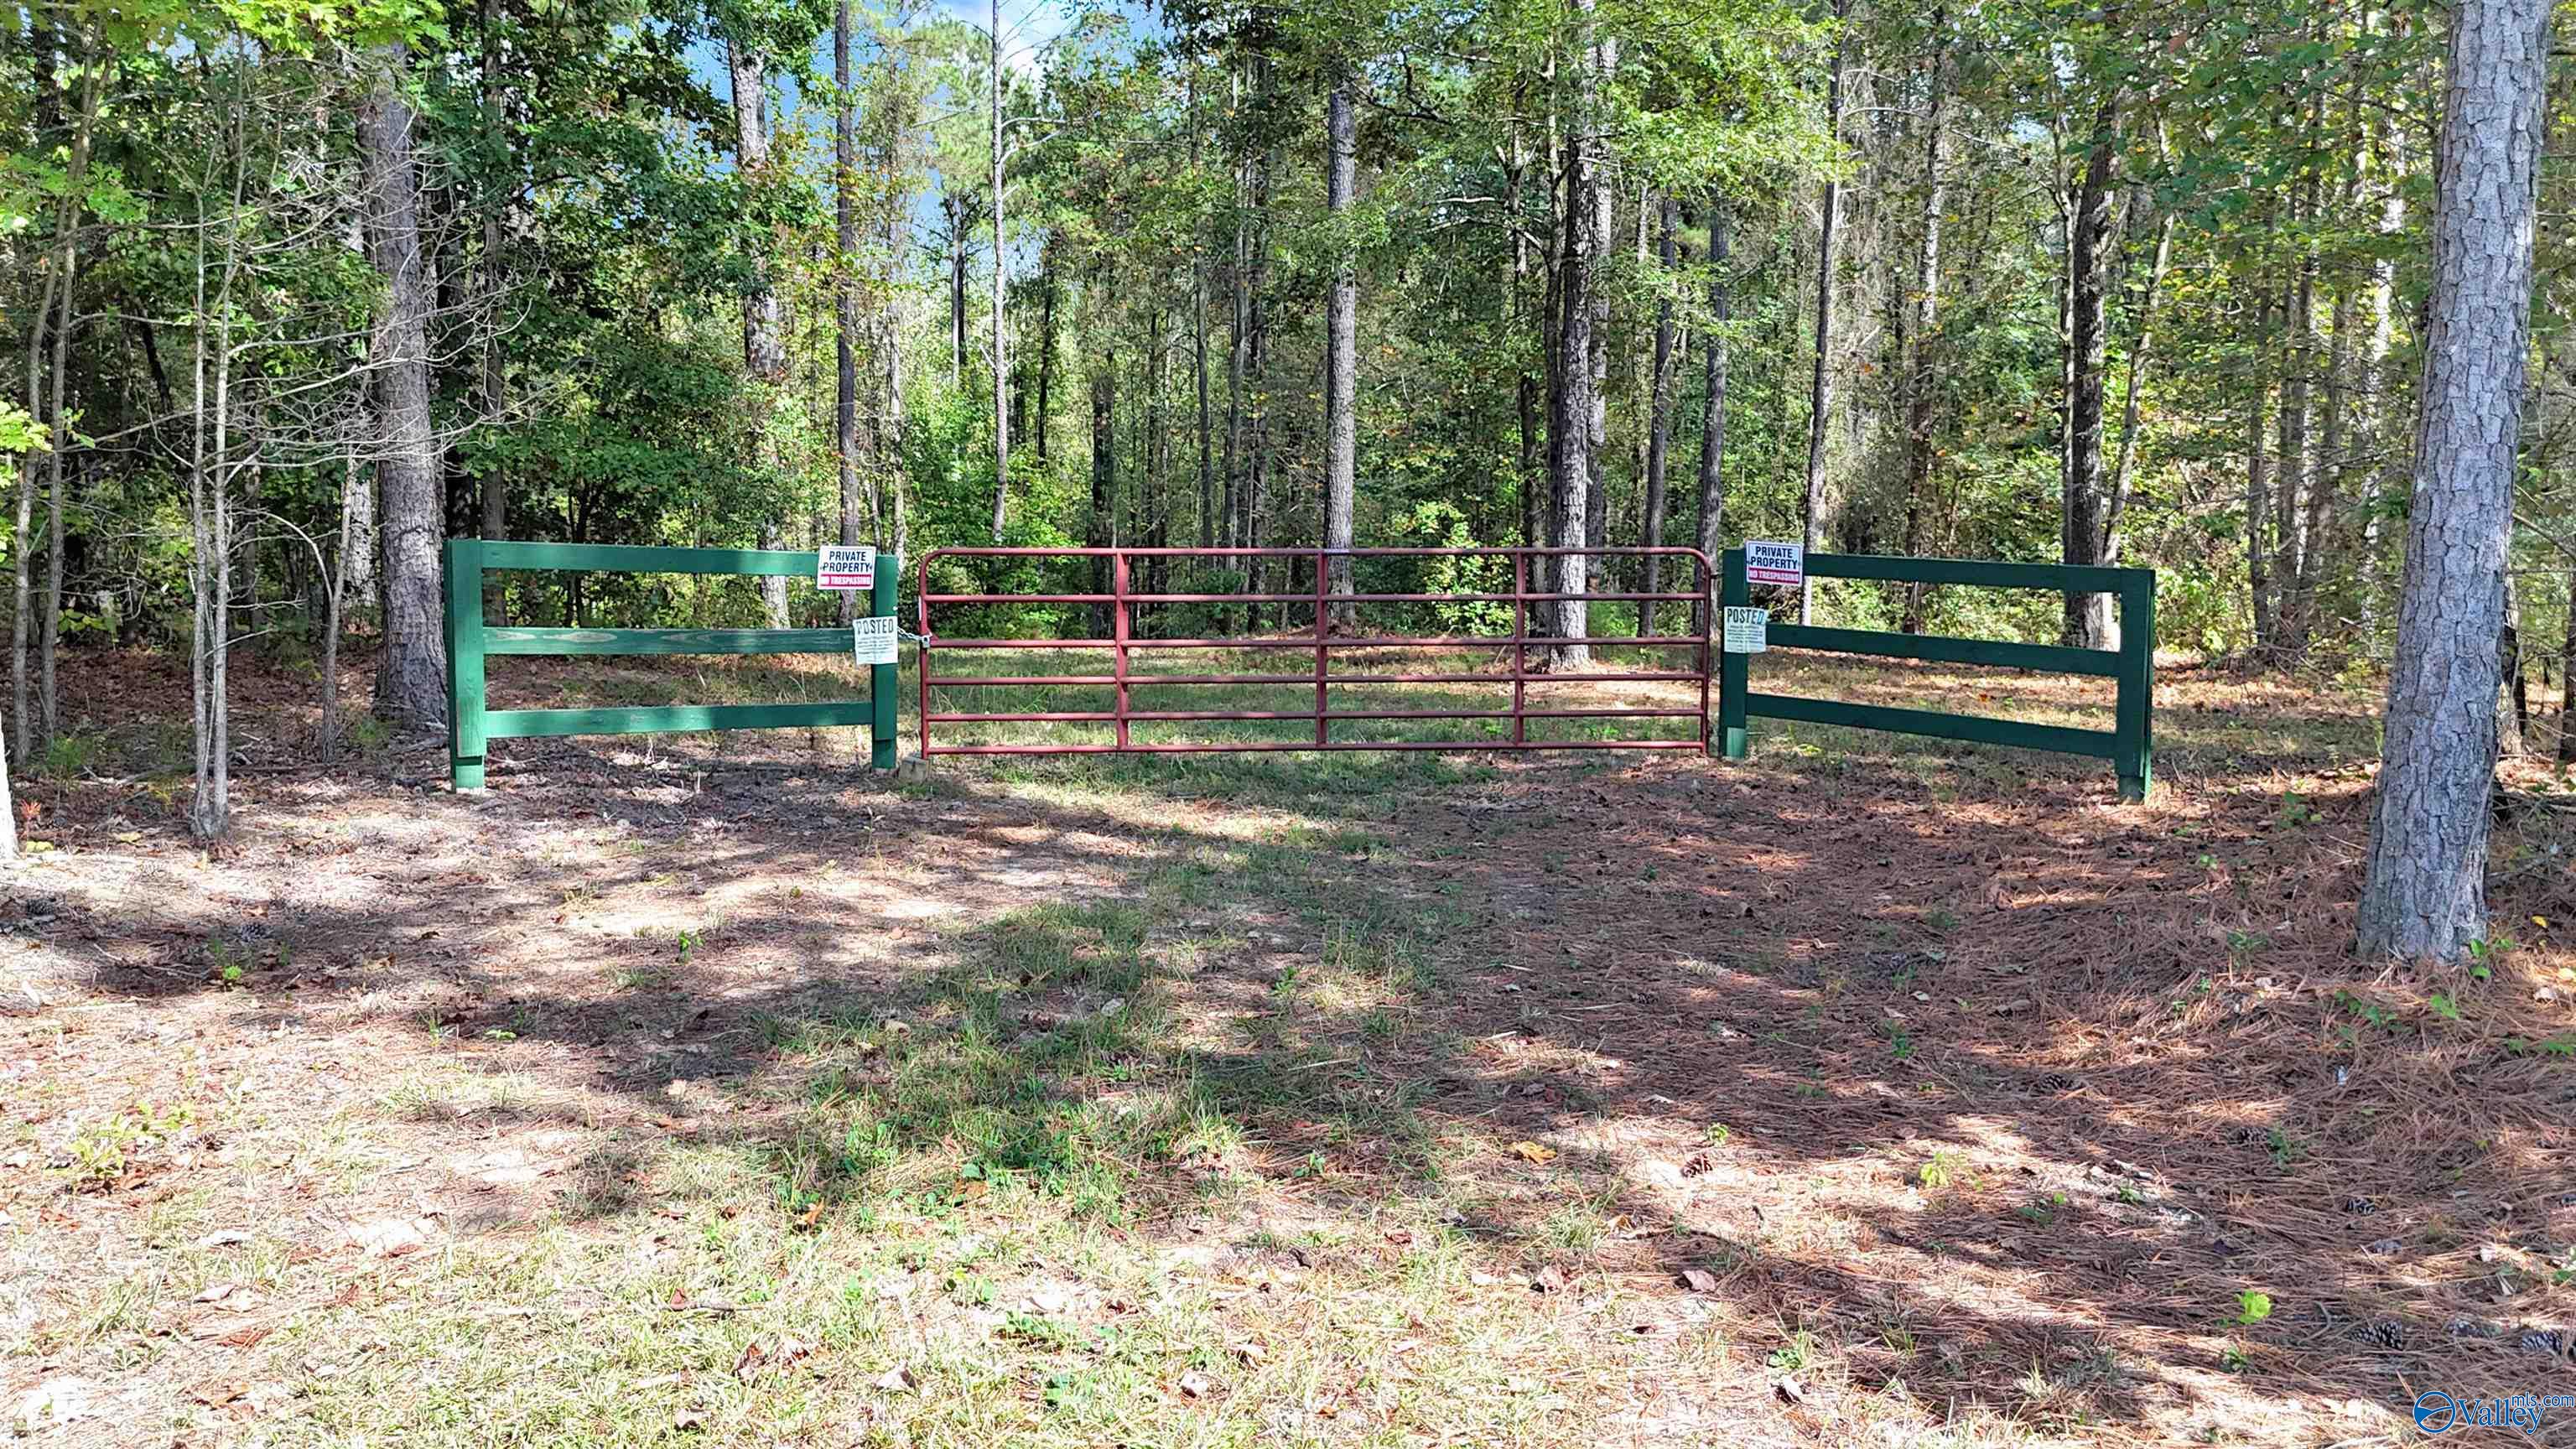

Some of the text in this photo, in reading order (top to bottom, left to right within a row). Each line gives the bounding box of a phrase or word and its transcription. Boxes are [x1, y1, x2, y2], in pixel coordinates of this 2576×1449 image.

[829, 551, 866, 561] PRIVATE
[1756, 546, 1793, 558] PRIVATE
[823, 562, 870, 572] PROPERTY
[1750, 556, 1798, 569] PROPERTY
[1727, 608, 1764, 625] POSTED
[856, 619, 894, 635] POSTED
